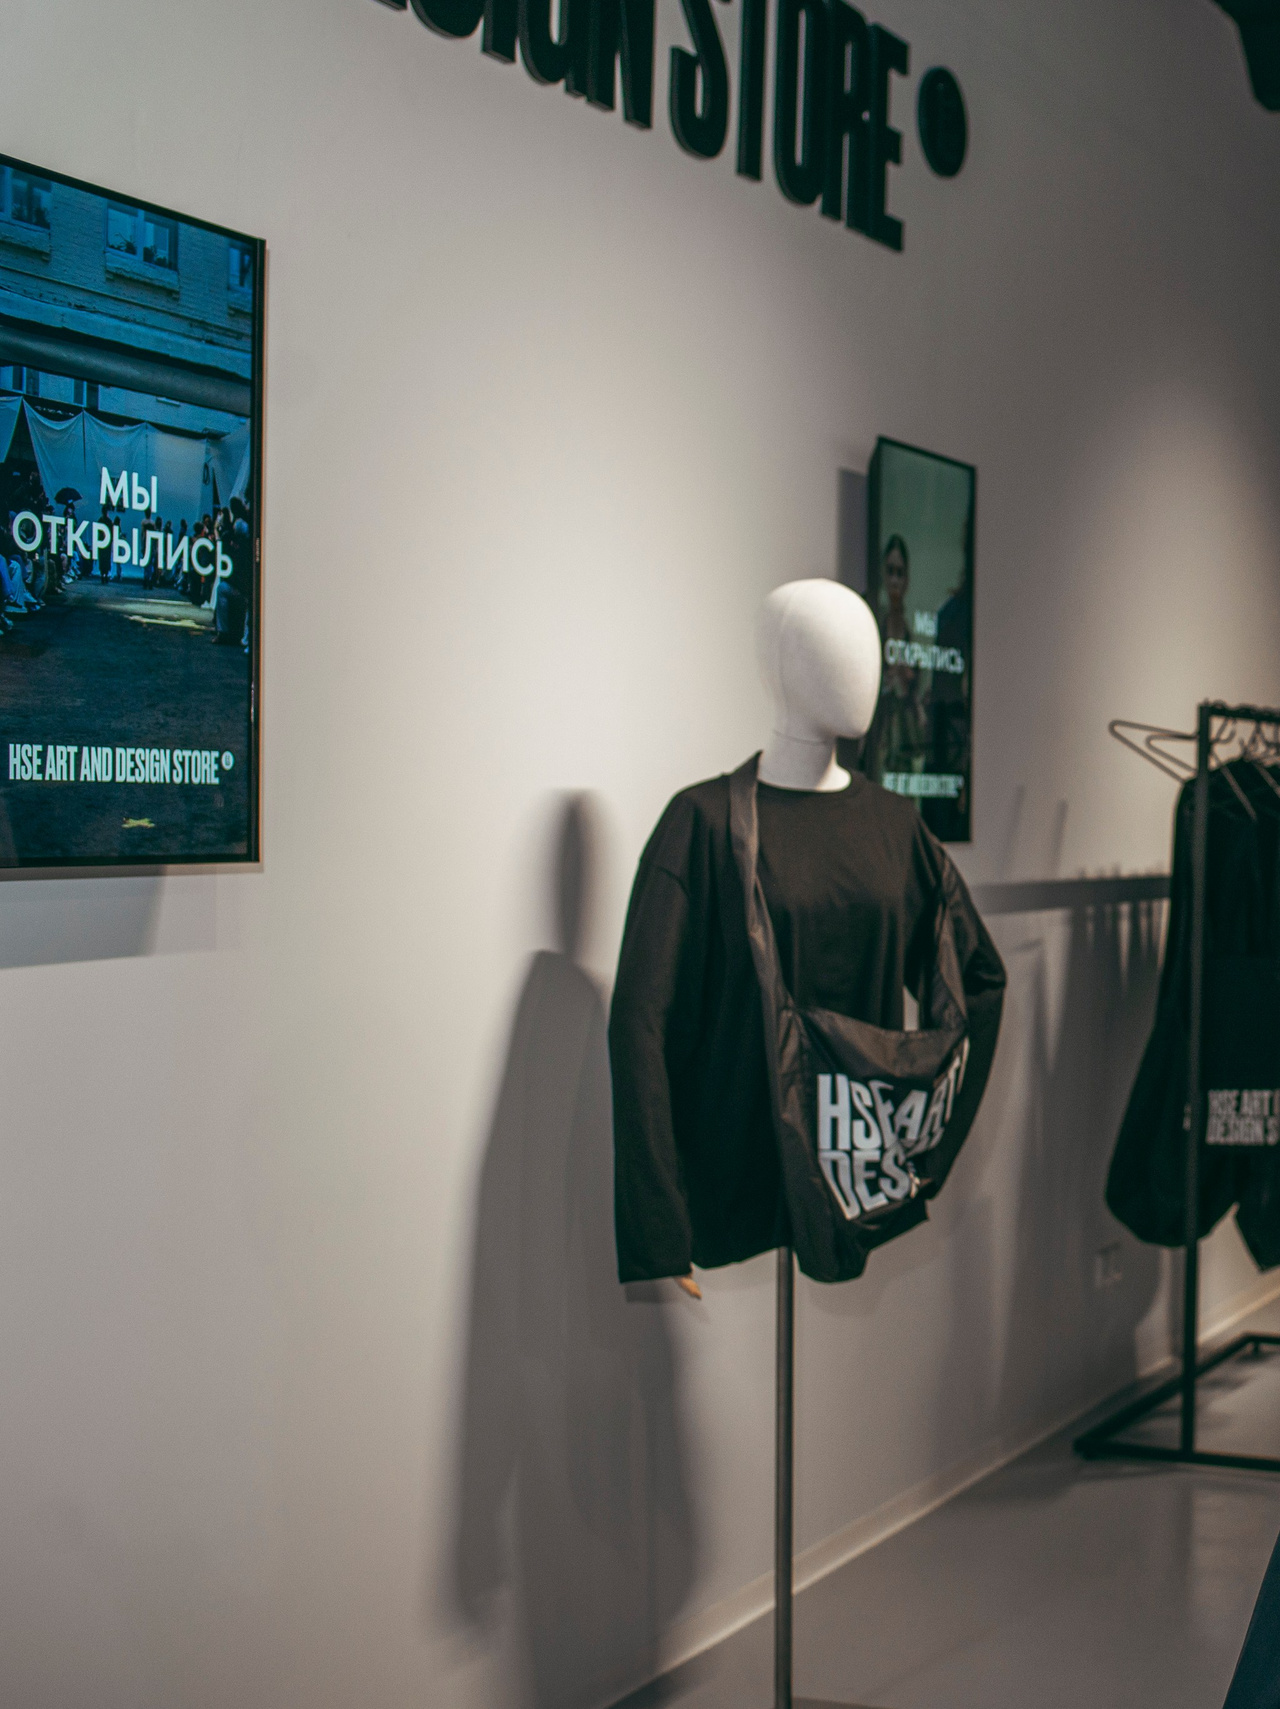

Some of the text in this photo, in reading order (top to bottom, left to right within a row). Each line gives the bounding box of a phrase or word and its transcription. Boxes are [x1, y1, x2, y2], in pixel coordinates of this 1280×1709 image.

[99, 466, 158, 513] МЫ
[12, 511, 234, 578] ОТКРЫЛИСЬ
[8, 743, 220, 785] HSE ART AND DESIGN STORE
